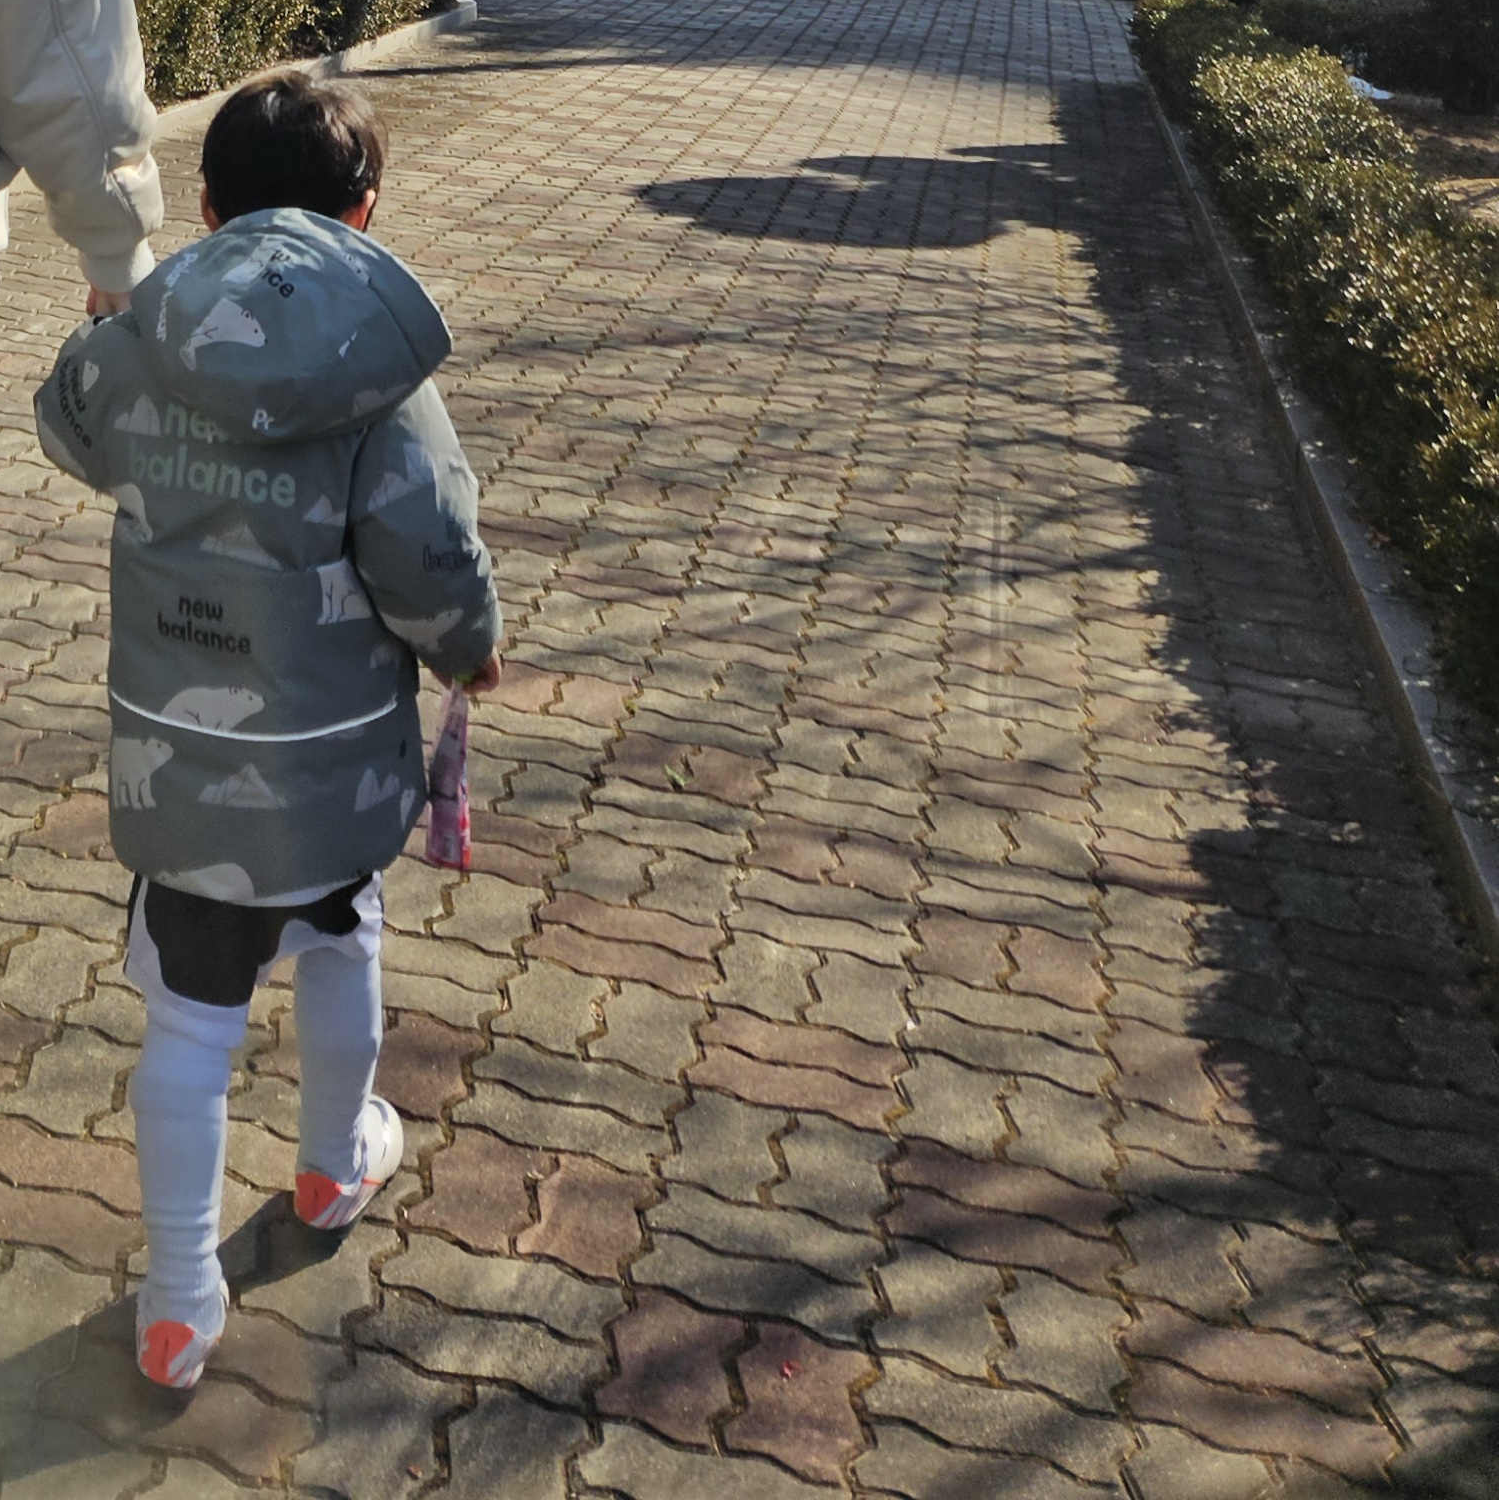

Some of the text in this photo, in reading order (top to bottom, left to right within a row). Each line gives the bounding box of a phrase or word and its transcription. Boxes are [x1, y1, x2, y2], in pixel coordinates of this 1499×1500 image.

[129, 437, 296, 509] balance
[178, 596, 224, 622] new
[157, 611, 252, 655] balance
